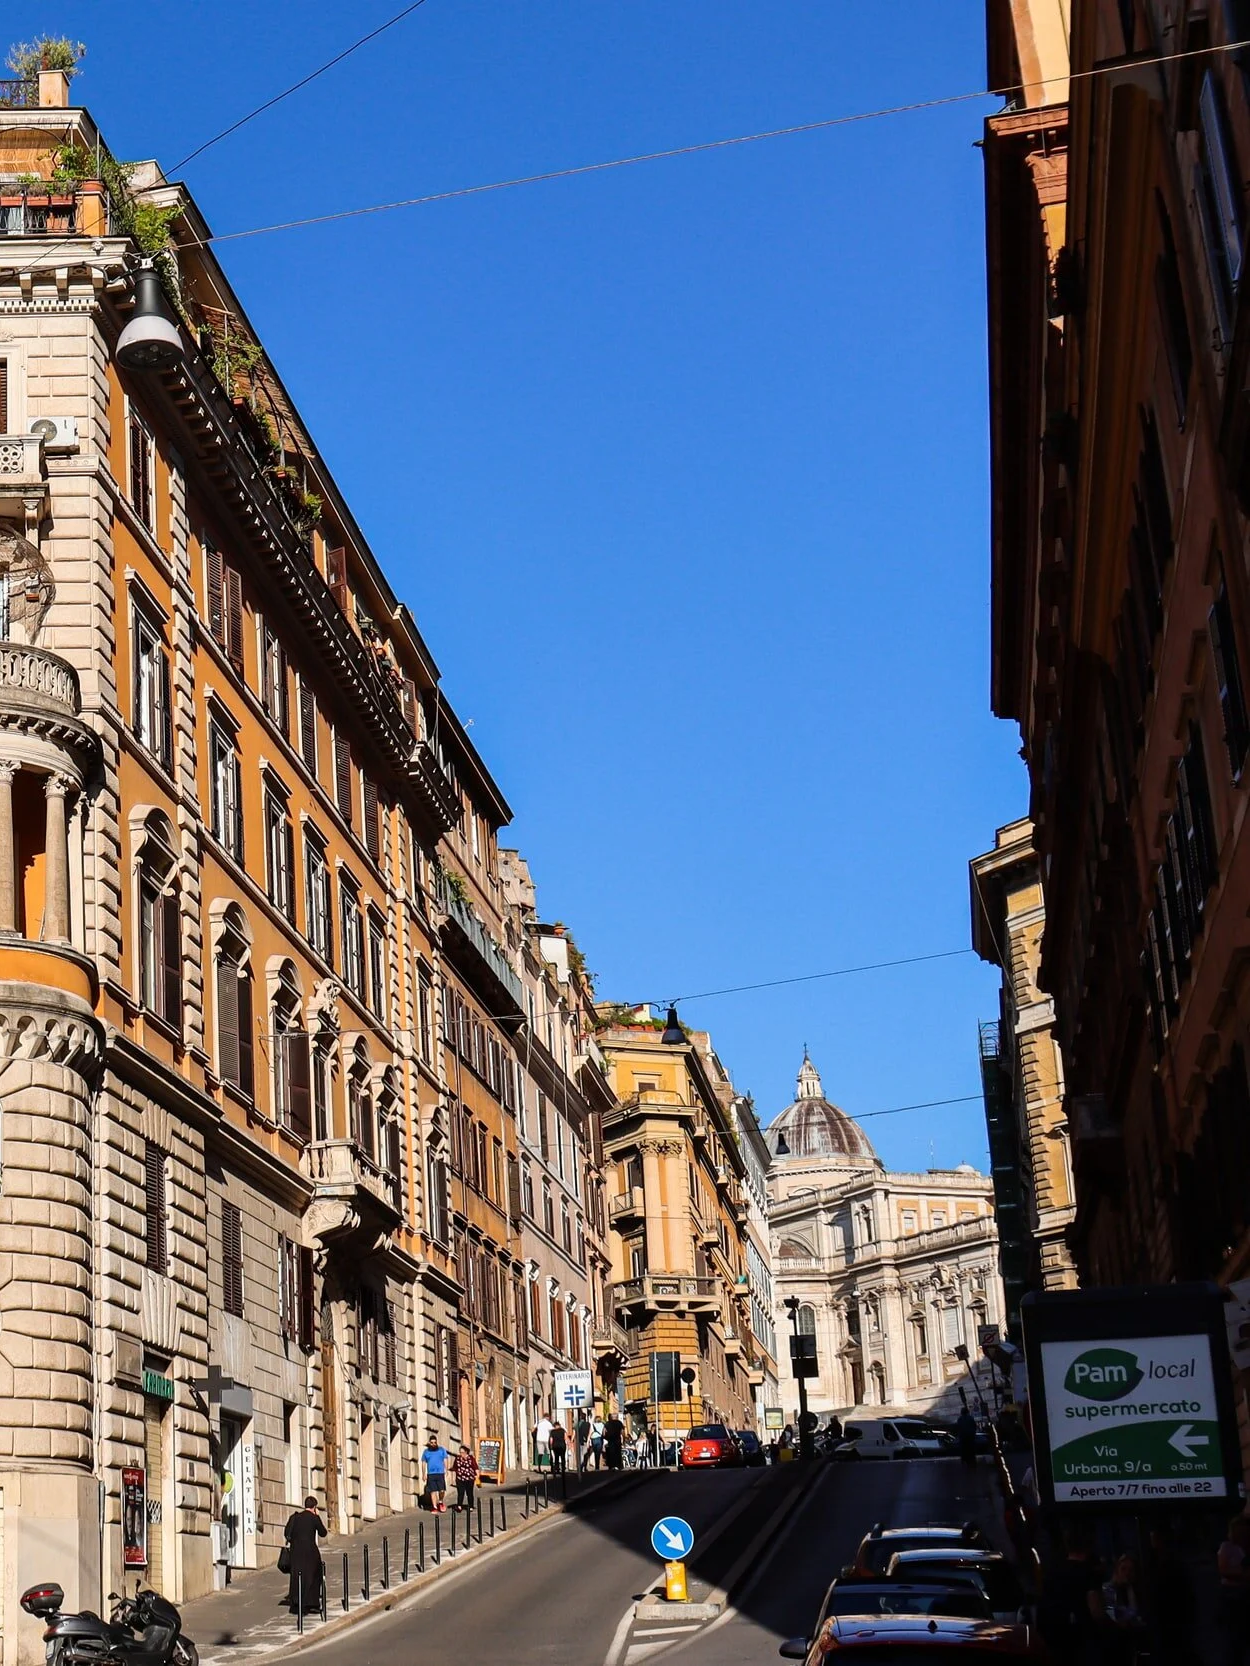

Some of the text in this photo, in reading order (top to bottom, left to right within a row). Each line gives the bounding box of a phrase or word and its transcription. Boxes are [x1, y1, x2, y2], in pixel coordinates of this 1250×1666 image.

[1074, 1358, 1195, 1384] Pam local
[1065, 1399, 1201, 1421] supermercato
[1093, 1445, 1118, 1457] Via
[1064, 1460, 1152, 1475] Urbana, 9/a
[1179, 1462, 1193, 1471] 50
[1194, 1462, 1208, 1471] mt
[1070, 1482, 1212, 1498] Aperto 7/7 fino alle 22
